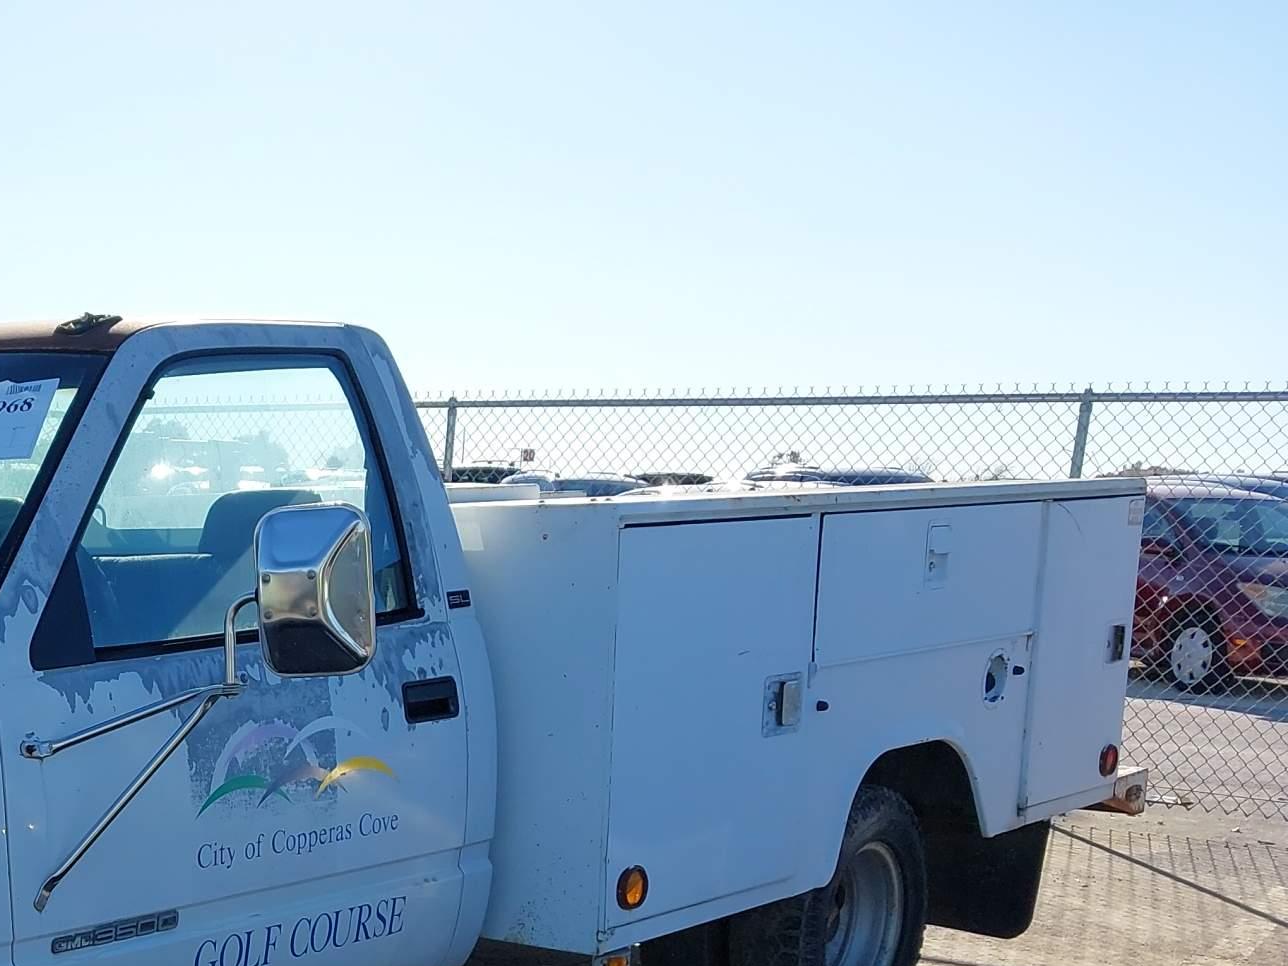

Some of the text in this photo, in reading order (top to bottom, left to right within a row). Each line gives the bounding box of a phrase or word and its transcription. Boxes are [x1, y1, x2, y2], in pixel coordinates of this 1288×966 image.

[197, 812, 400, 869] City of Copperas Cove
[290, 896, 407, 958] COURSE
